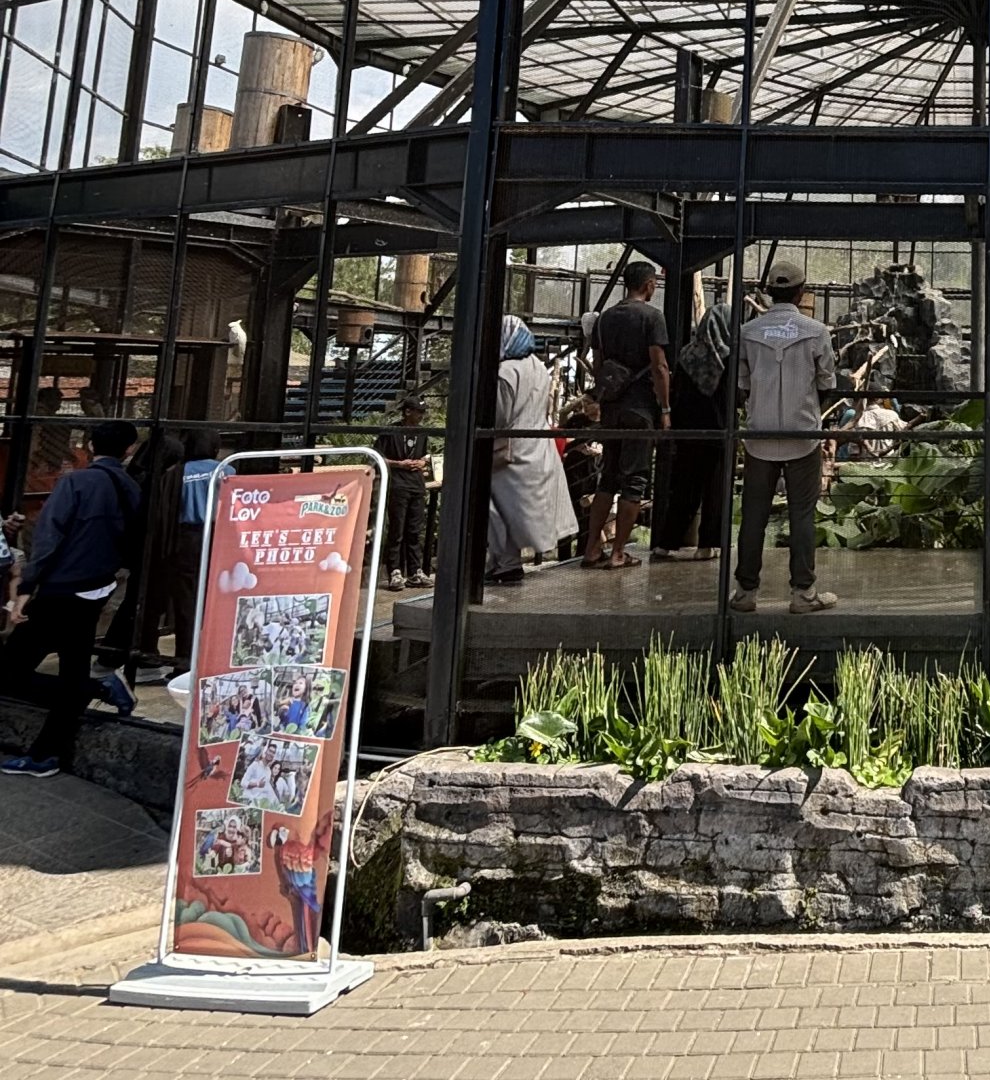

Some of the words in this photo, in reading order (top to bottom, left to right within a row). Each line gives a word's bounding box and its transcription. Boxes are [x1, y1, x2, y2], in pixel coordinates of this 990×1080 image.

[231, 488, 270, 505] Foto
[240, 529, 289, 548] LET'S
[300, 528, 337, 545] GET
[254, 546, 316, 565] PHOTO
